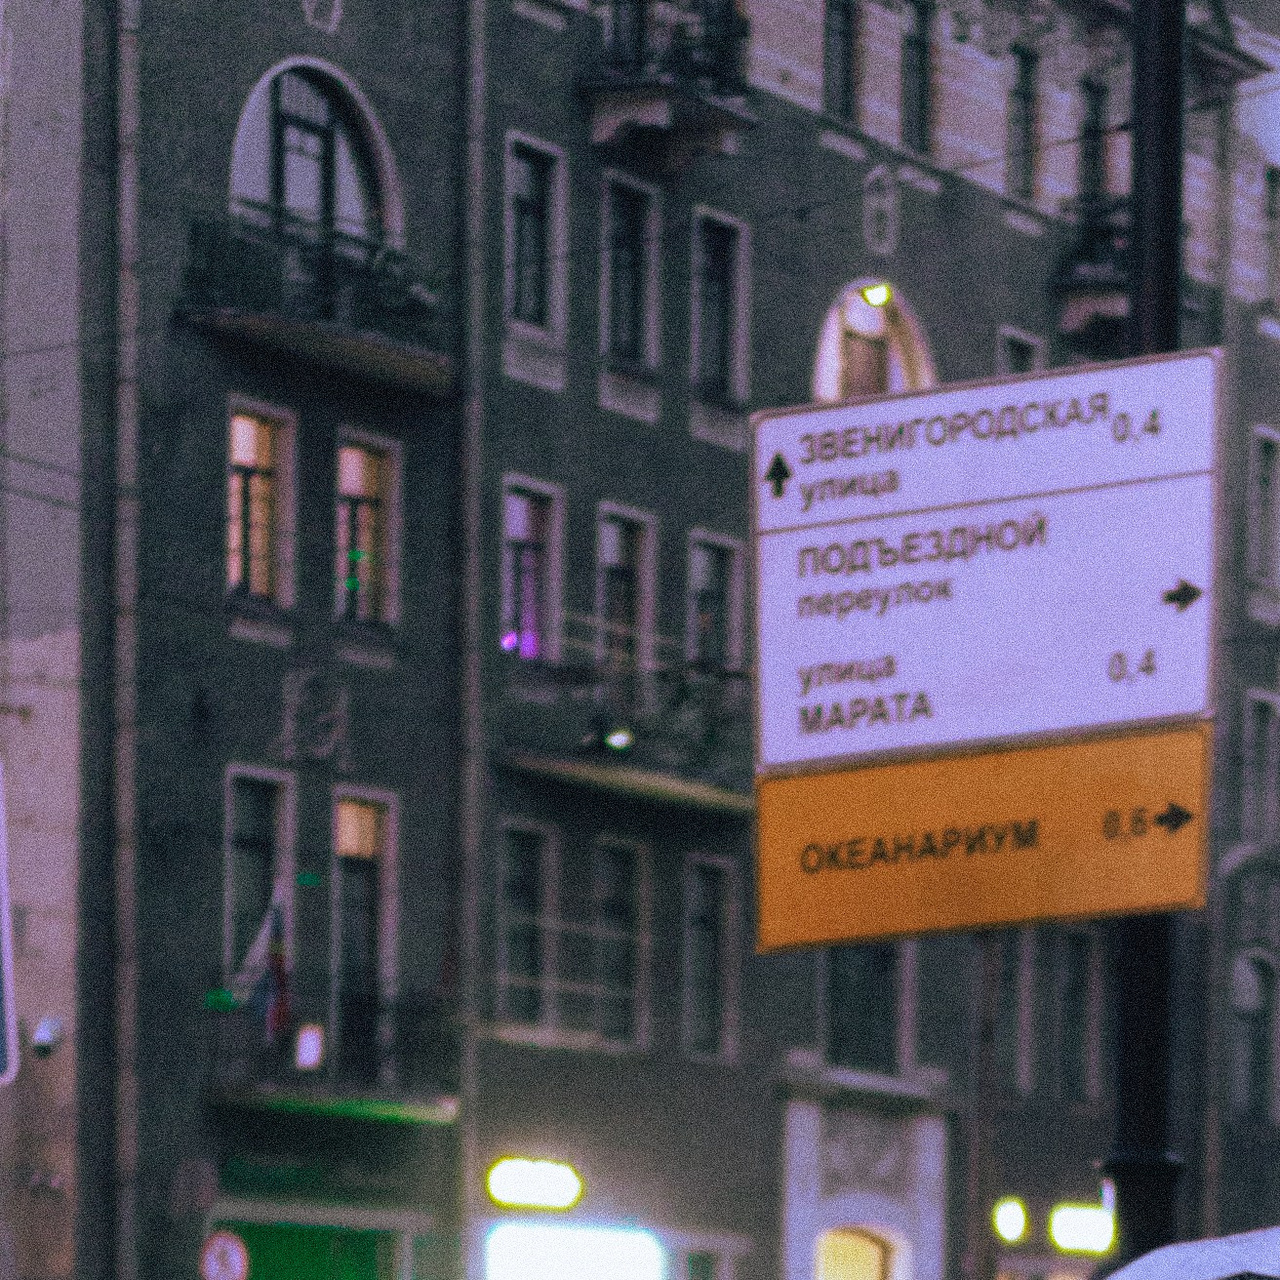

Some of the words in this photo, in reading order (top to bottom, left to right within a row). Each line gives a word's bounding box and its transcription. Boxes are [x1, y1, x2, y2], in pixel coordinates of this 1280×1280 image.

[799, 392, 1110, 465] ЗВЕНИГОРОДСКАЯ
[799, 470, 899, 512] улица
[797, 510, 1048, 578] ПОДЪЕЗДНОЙ
[796, 577, 952, 619] переулок
[797, 655, 896, 696] улица
[798, 691, 932, 734] МАРАТА
[800, 818, 1039, 874] ОКЕАНАРИУМ
